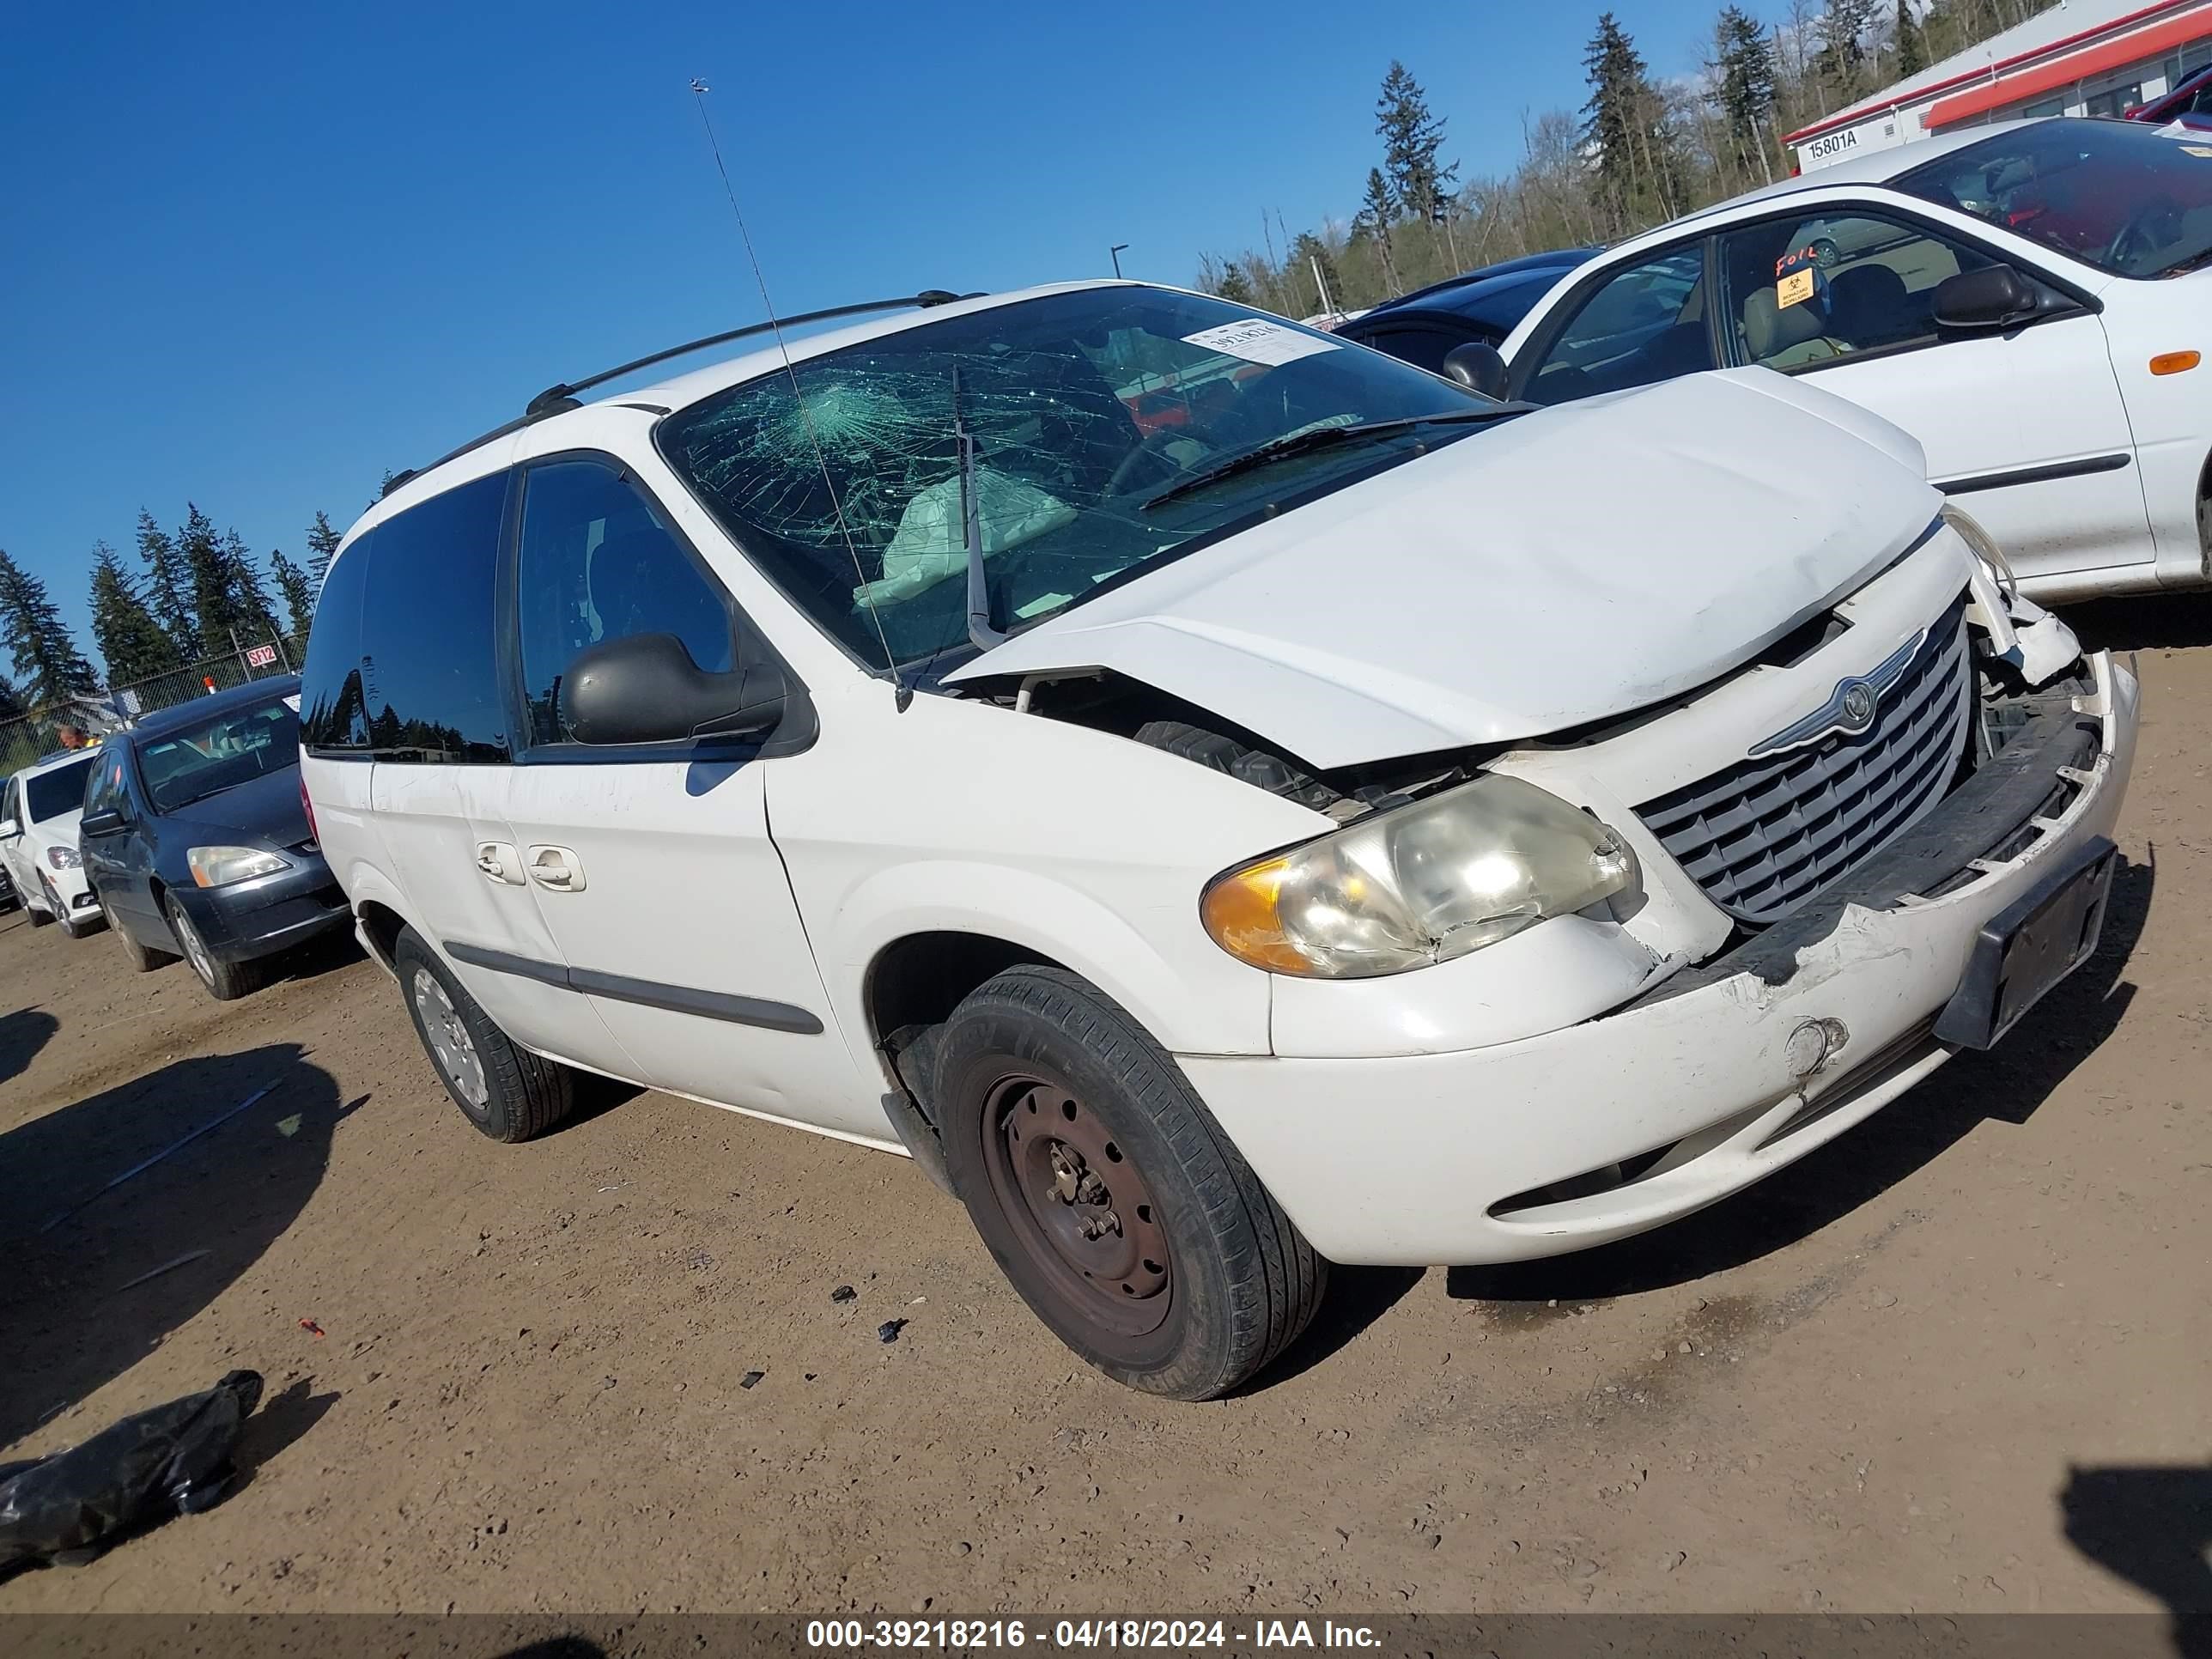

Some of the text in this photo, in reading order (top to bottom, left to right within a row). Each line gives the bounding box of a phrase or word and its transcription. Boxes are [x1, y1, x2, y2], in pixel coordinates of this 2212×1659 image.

[1808, 130, 1857, 160] 15801A
[1775, 246, 1818, 277] FOIL
[1210, 325, 1281, 349] 39218216
[249, 647, 276, 665] SF12
